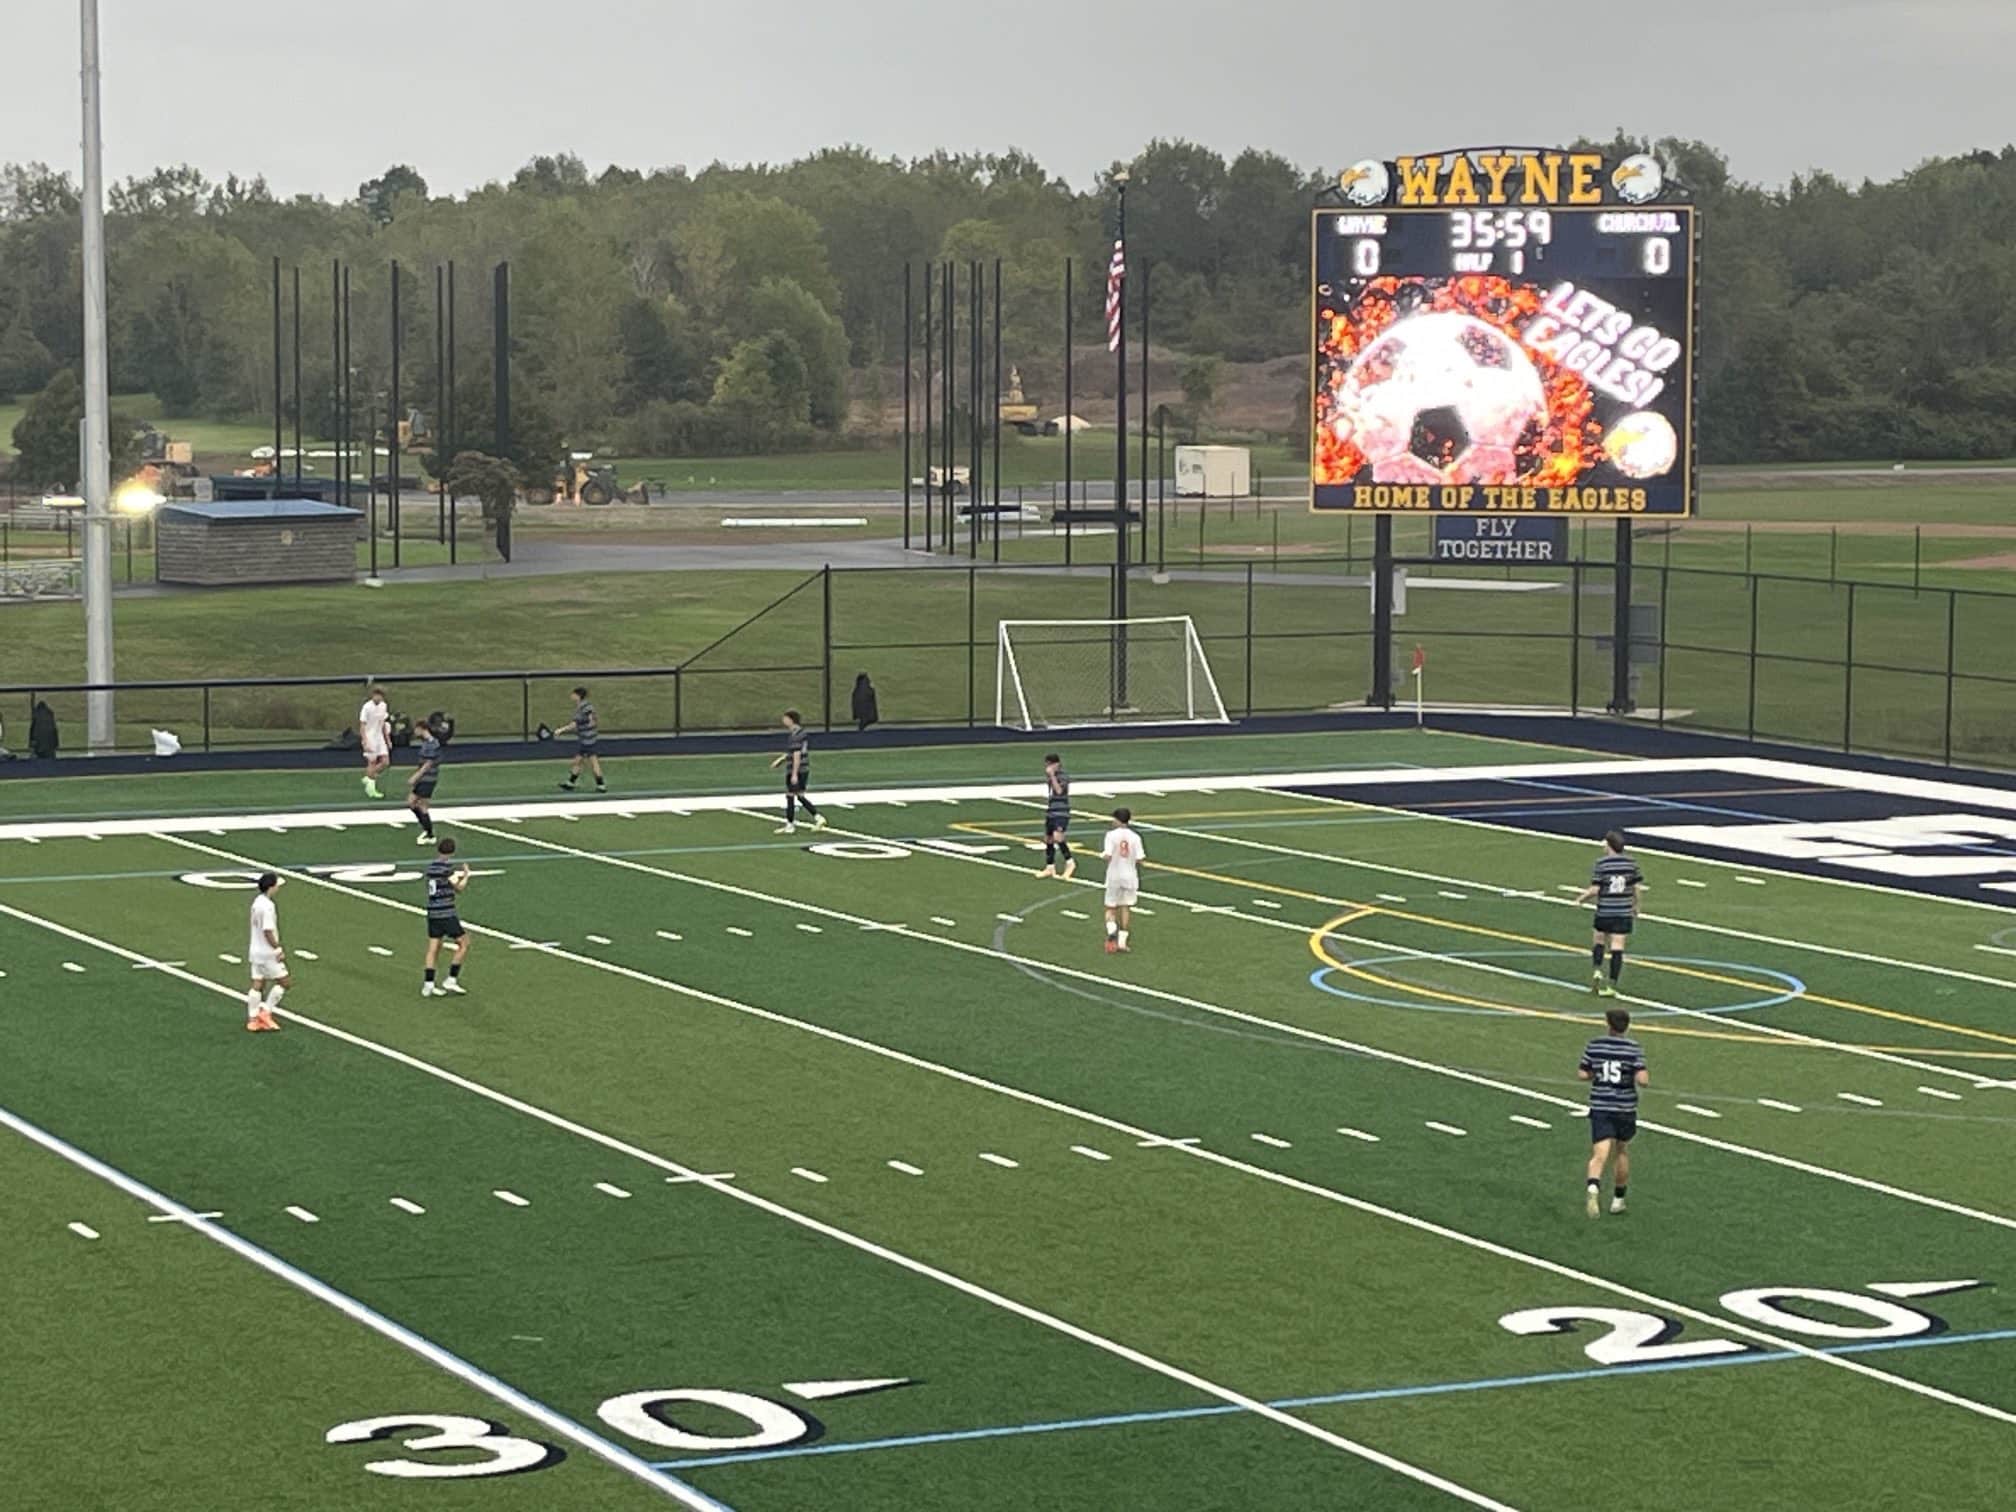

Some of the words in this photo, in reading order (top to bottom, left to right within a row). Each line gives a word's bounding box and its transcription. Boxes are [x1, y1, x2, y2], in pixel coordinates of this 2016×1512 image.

[1396, 154, 1602, 205] WAYNE
[1451, 210, 1551, 248] 35:59
[1355, 239, 1380, 275] 0
[1512, 250, 1524, 275] 1
[1645, 237, 1670, 274] 0
[1523, 316, 1664, 409] EAGLES!
[1619, 325, 1681, 371] GO
[1354, 486, 1431, 509] HOME
[1441, 487, 1473, 510] OF
[1485, 487, 1536, 511] THE
[1549, 487, 1647, 512] EAGLES
[1475, 518, 1515, 537] FLY
[1439, 539, 1552, 560] TOGETHER
[1602, 1060, 1621, 1083] 15
